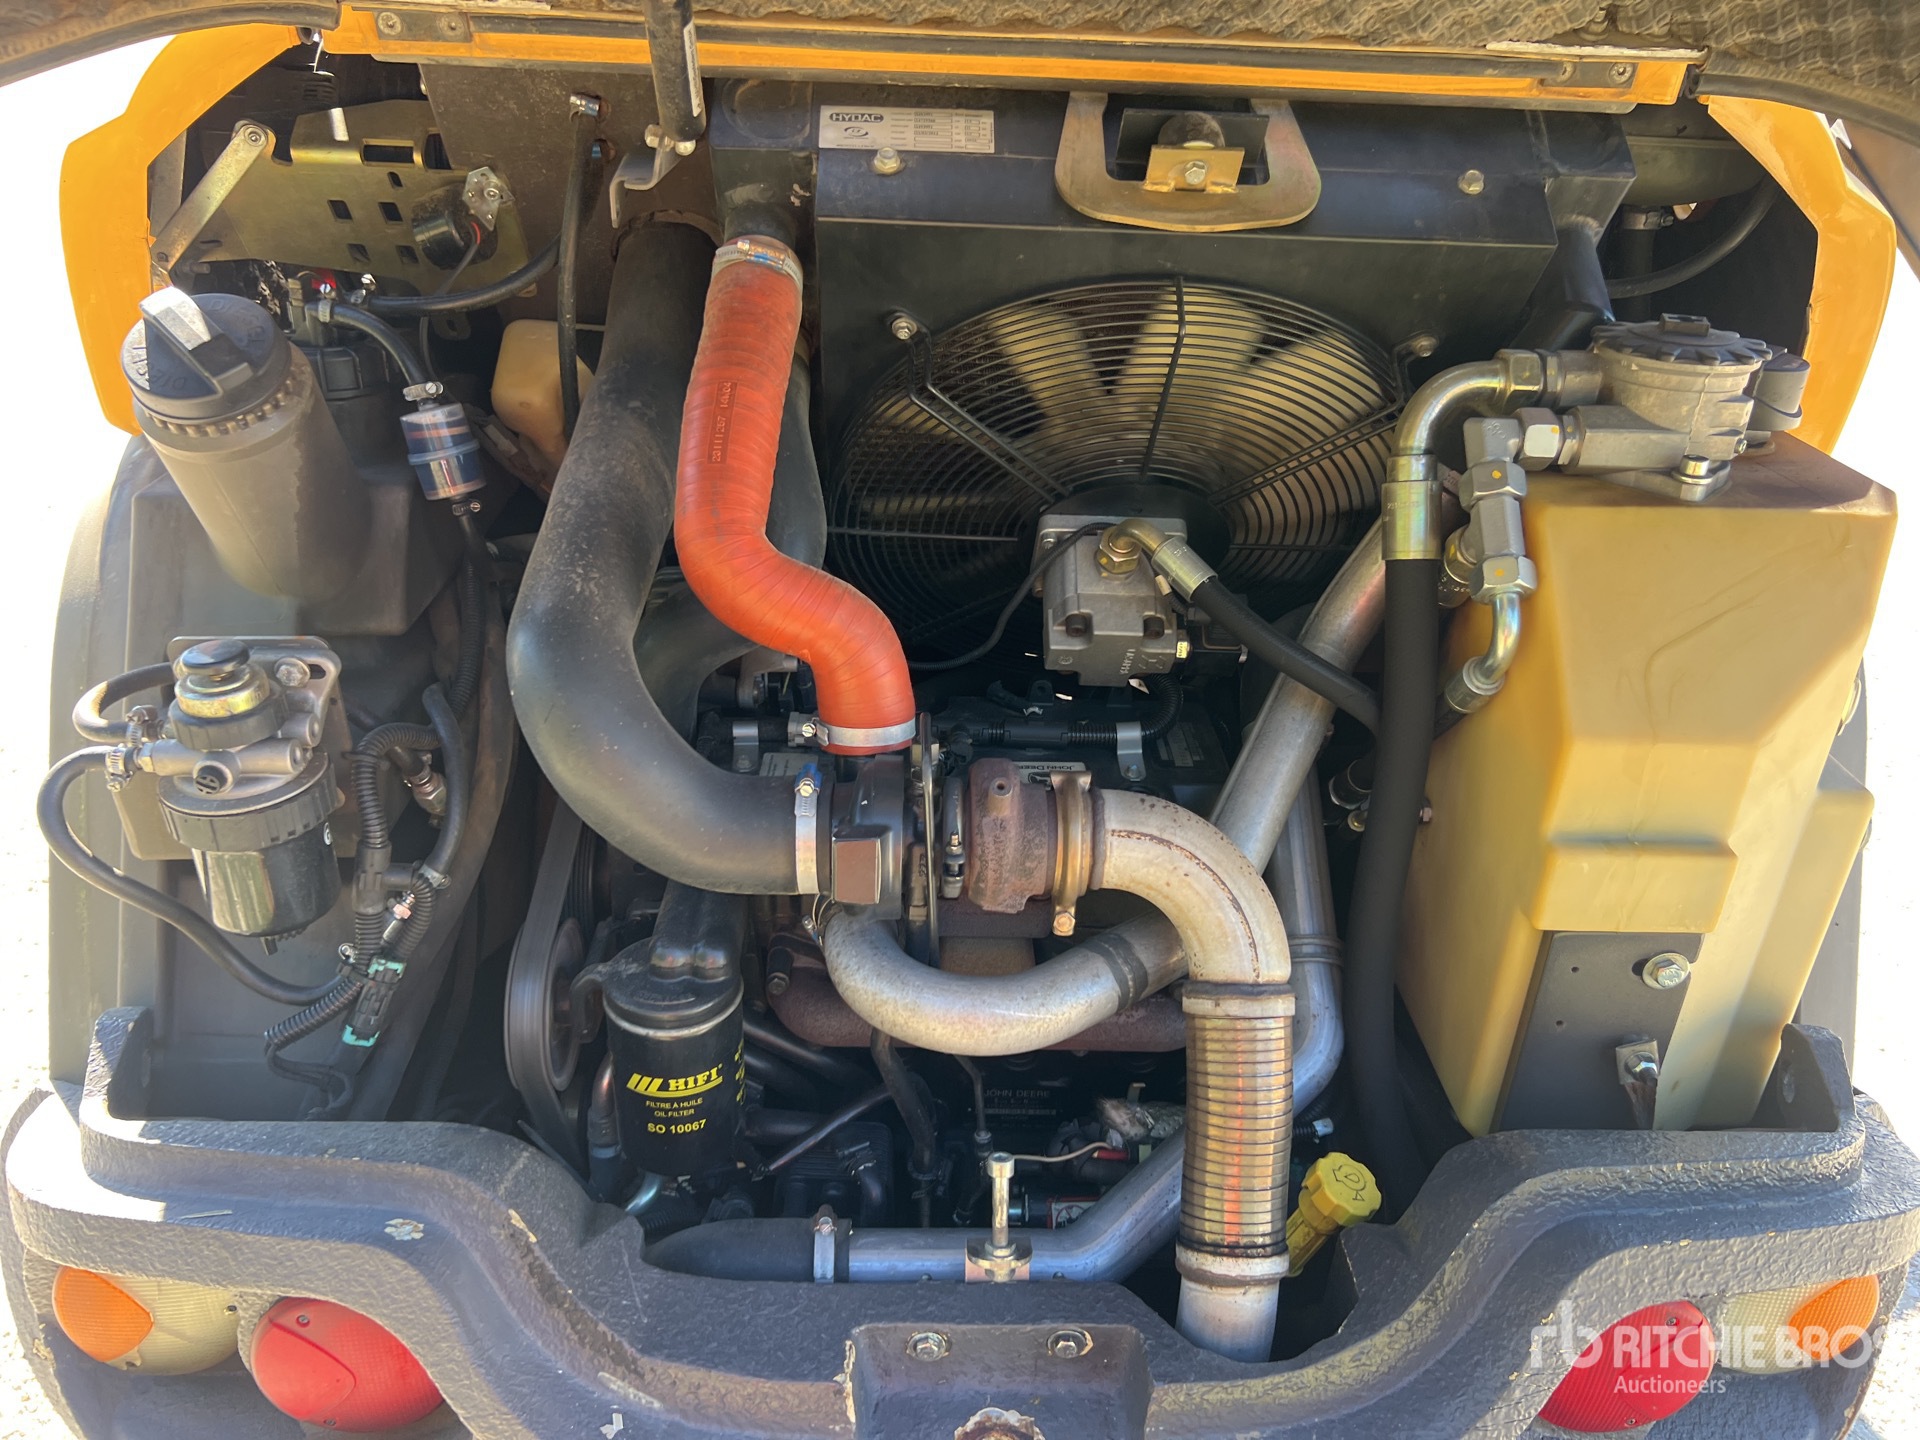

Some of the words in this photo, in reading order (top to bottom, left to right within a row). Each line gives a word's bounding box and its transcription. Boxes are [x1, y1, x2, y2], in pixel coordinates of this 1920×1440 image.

[830, 113, 883, 122] HYDAC
[668, 1067, 719, 1091] HIFI
[984, 1089, 1012, 1097] JOHN
[645, 1101, 671, 1109] FILTRE
[680, 1097, 703, 1107] HUILE
[668, 1109, 695, 1117] FILTER
[647, 1123, 666, 1134] SO
[670, 1119, 707, 1134] 10067
